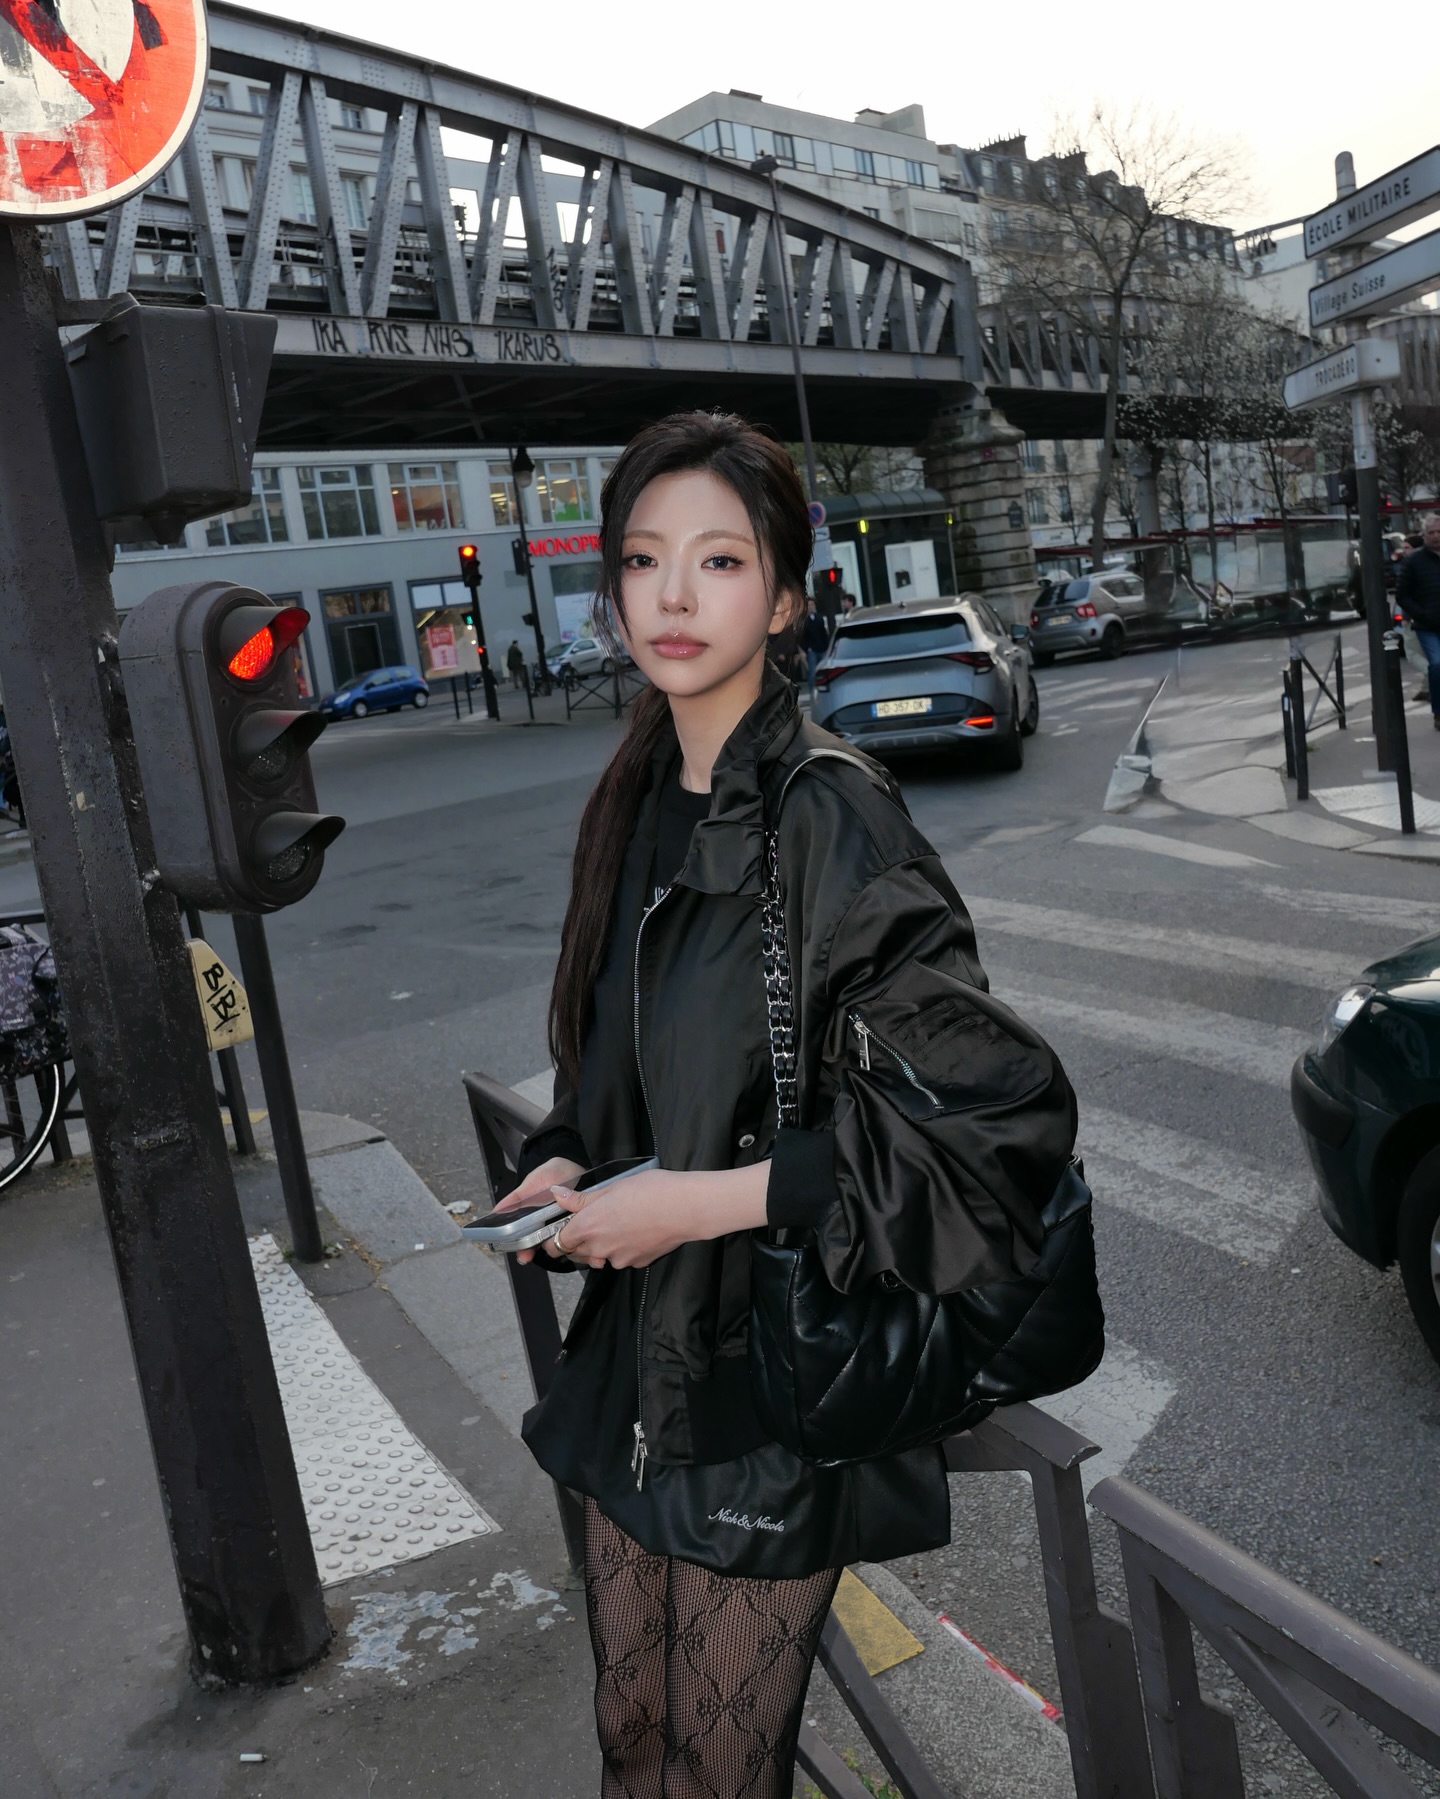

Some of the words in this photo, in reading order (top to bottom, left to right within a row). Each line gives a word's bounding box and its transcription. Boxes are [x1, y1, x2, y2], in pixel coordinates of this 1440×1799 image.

[1309, 213, 1342, 245] ÉCOLE
[1347, 177, 1411, 224] MILITAIRE
[1315, 291, 1347, 315] Village
[1351, 274, 1385, 299] Suisse
